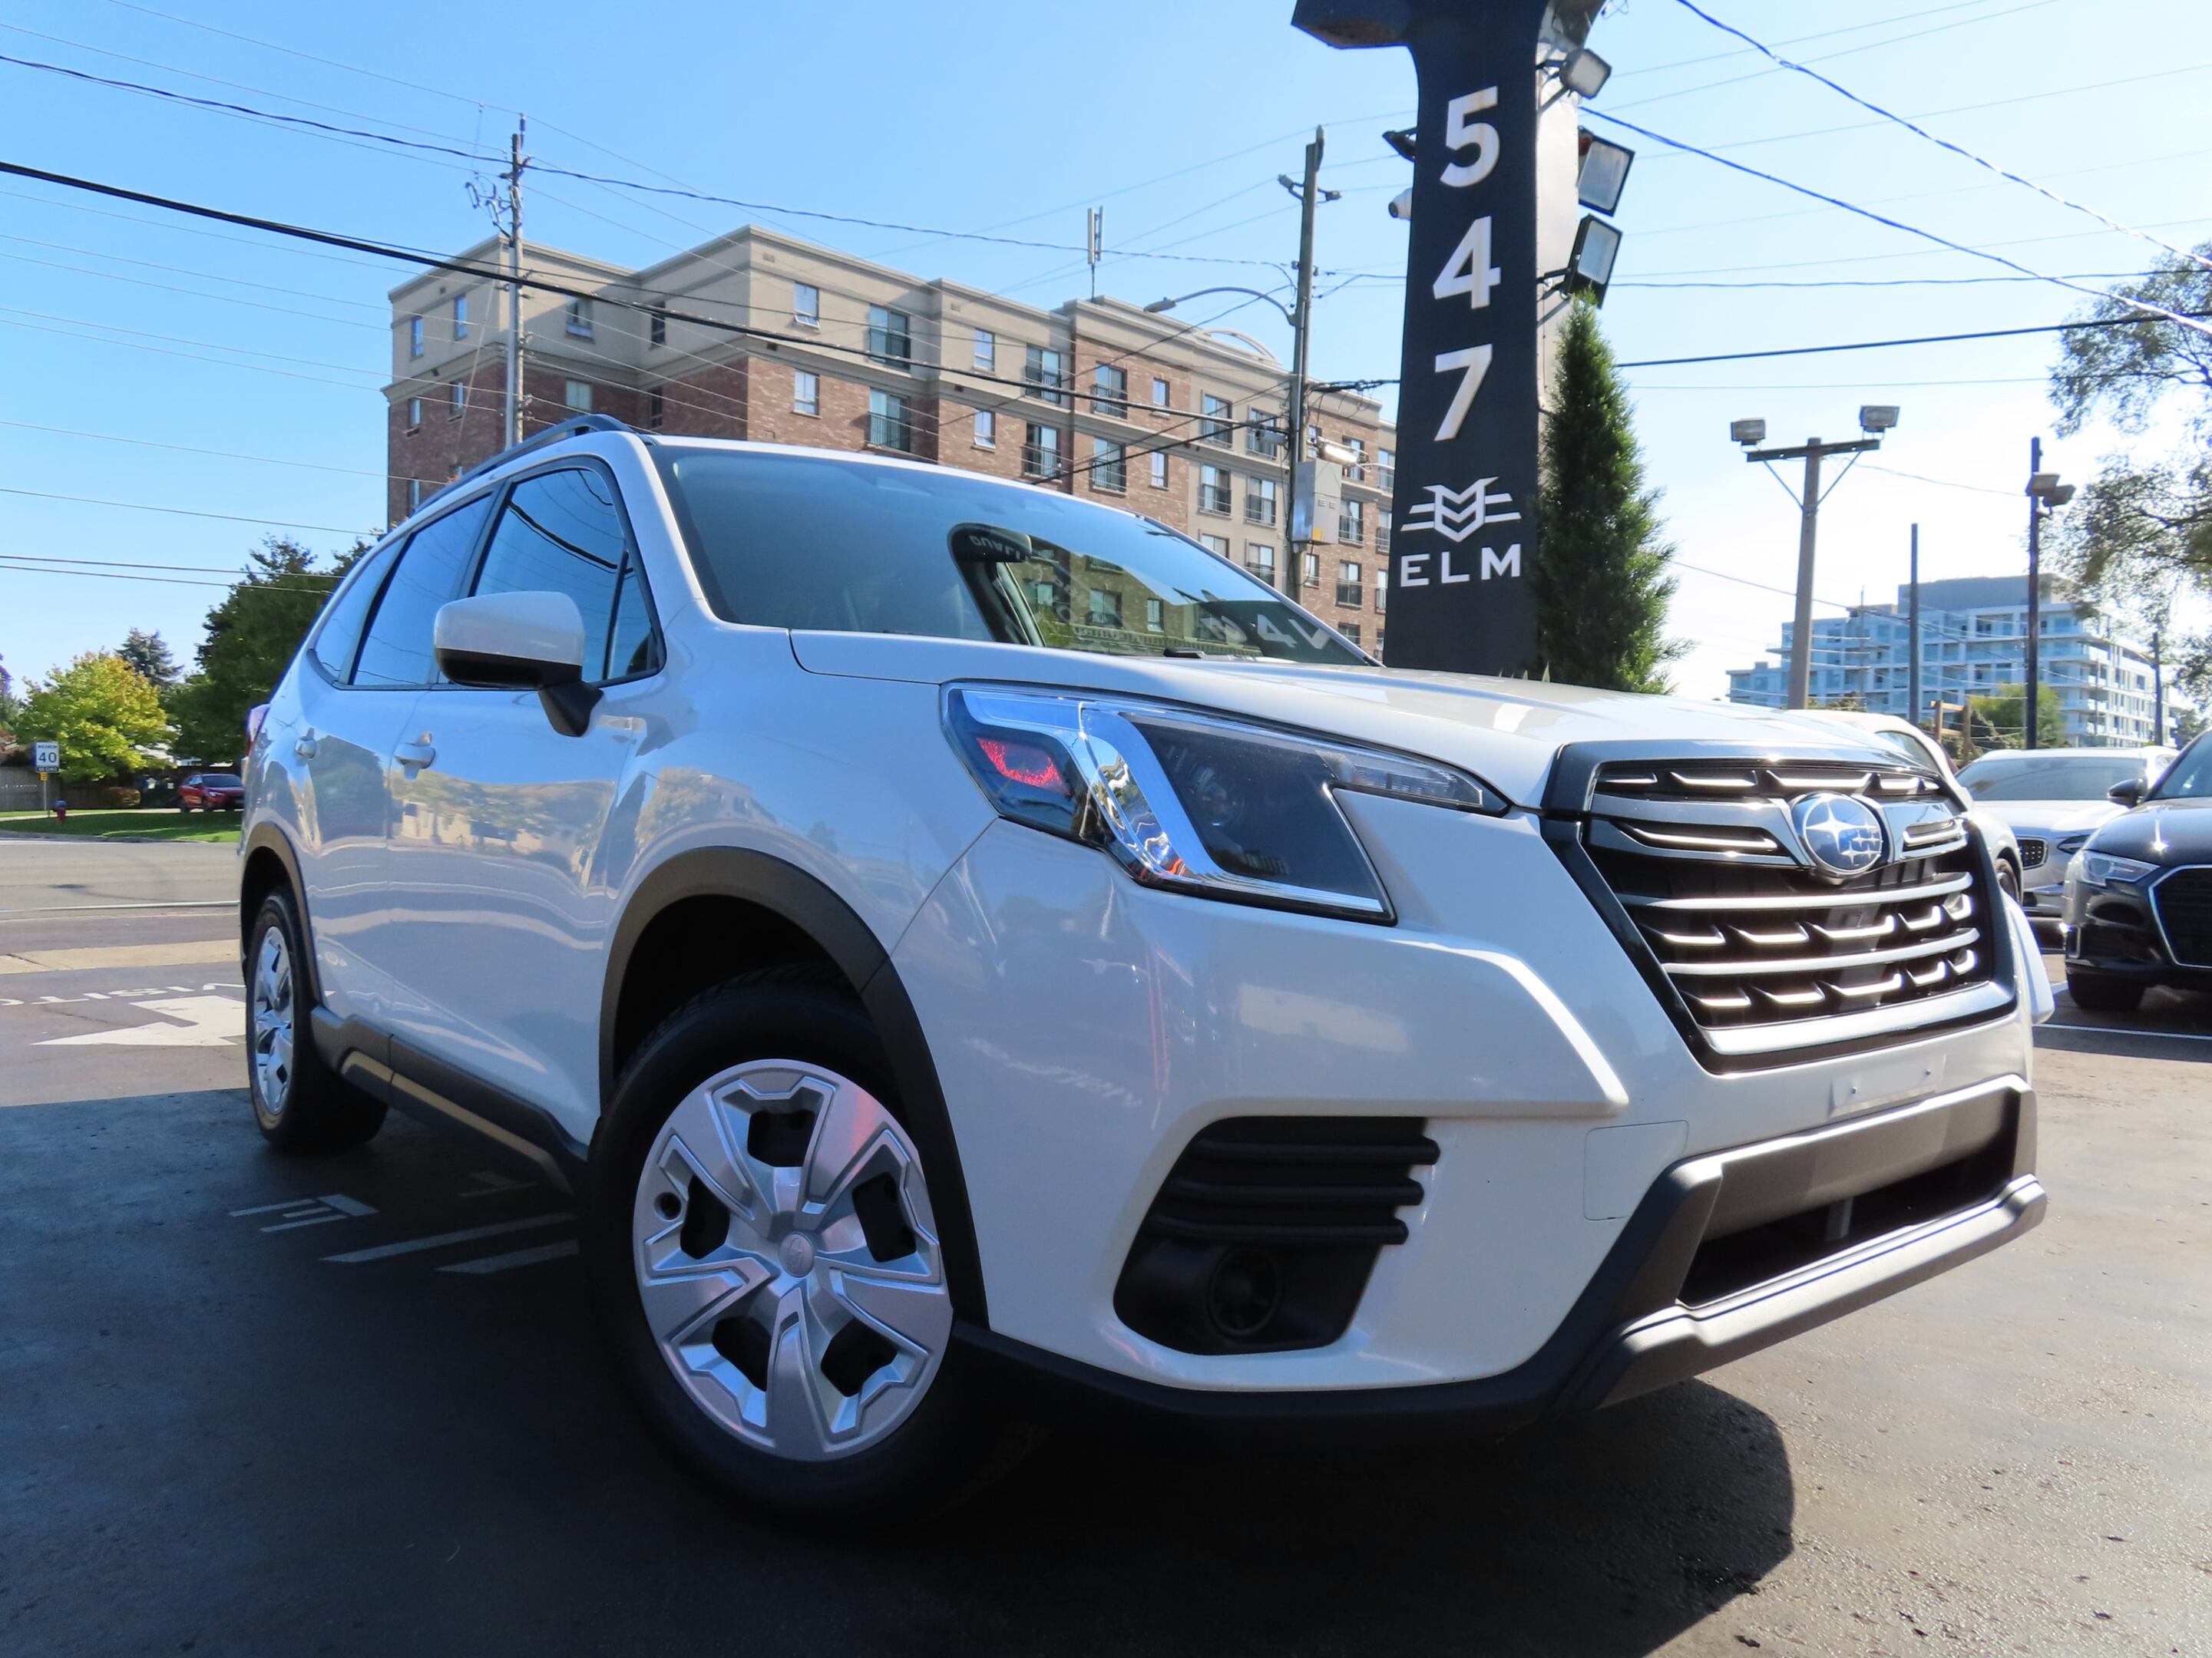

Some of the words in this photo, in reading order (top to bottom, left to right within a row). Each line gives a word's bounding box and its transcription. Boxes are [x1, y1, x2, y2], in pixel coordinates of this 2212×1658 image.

[1433, 85, 1502, 442] 547
[1400, 543, 1521, 587] ELM
[38, 751, 57, 763] 40
